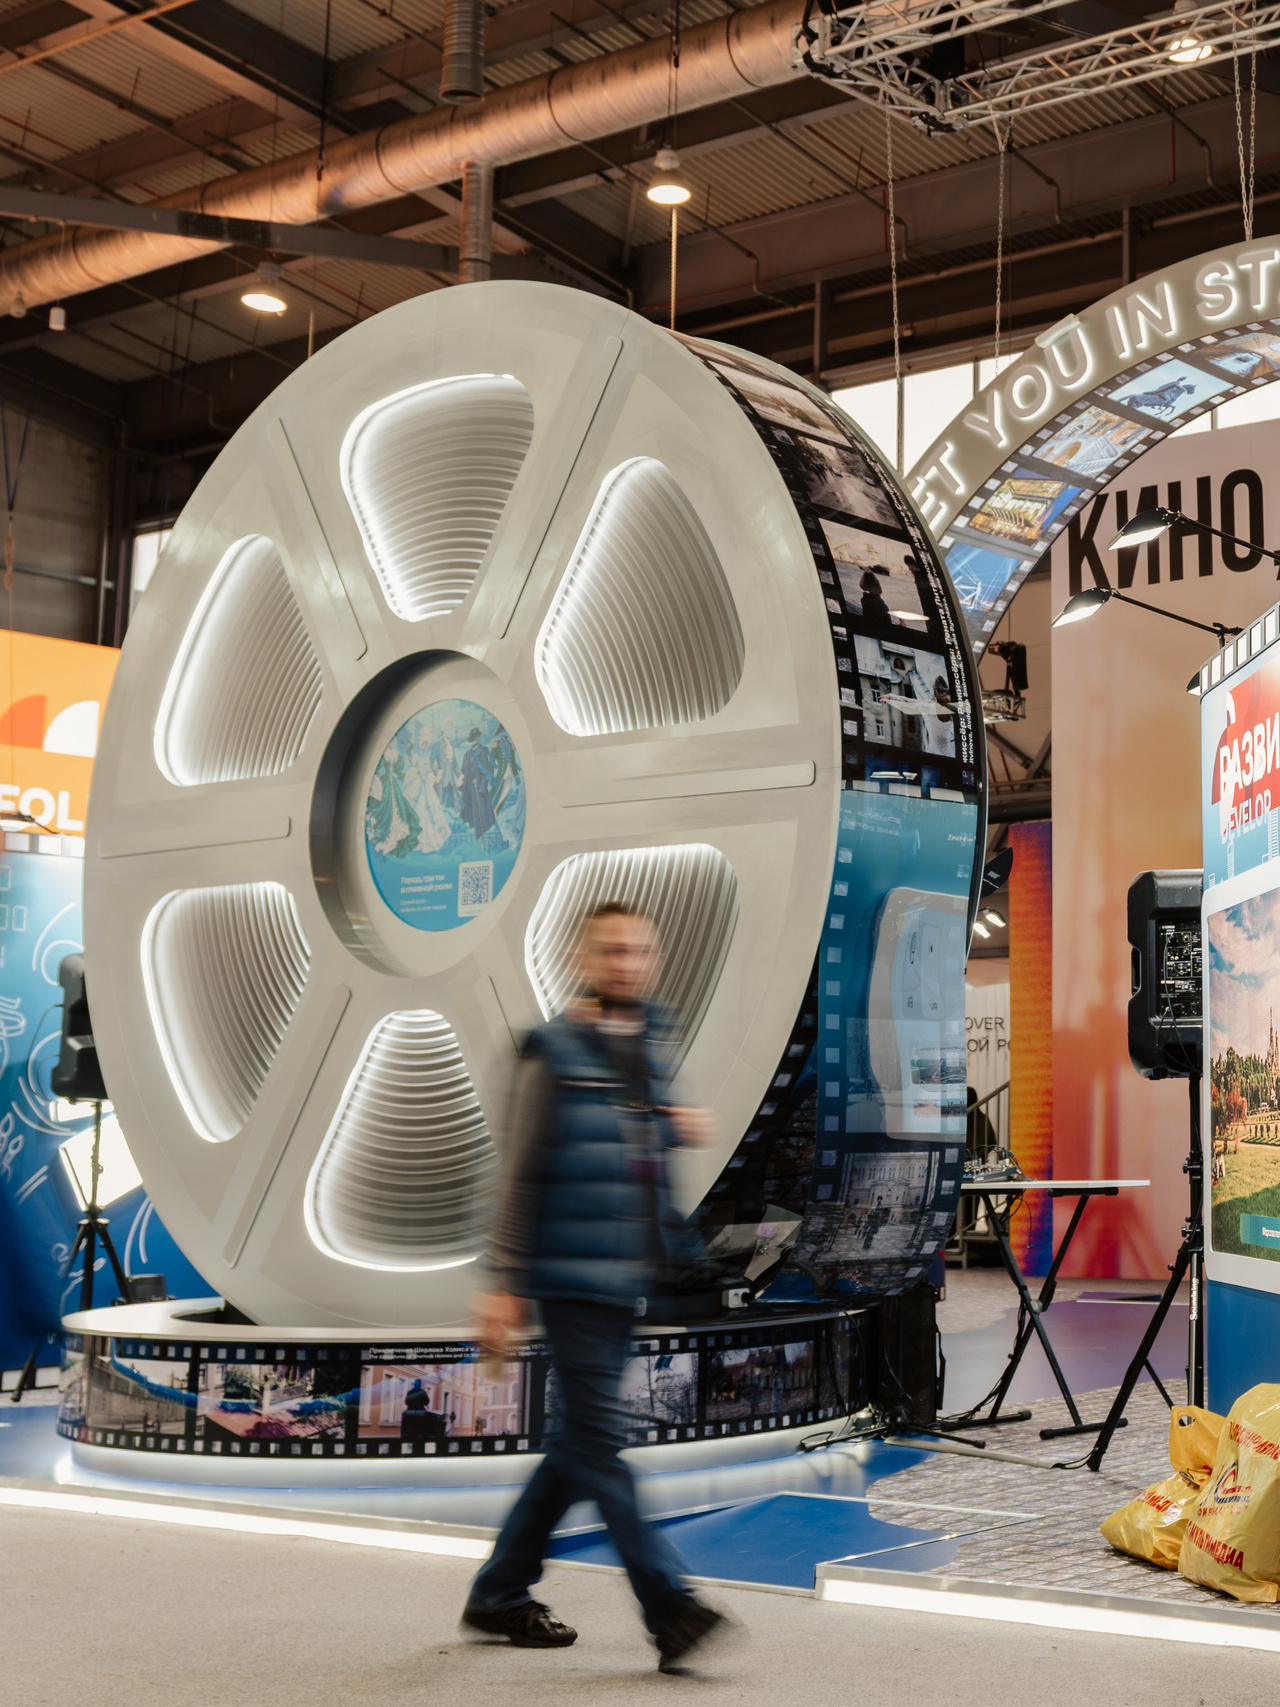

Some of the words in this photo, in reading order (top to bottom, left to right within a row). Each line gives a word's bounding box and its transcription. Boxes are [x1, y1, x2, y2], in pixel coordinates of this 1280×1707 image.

[962, 326, 1096, 449] YOU
[1103, 280, 1178, 360] IN
[1189, 1277, 1199, 1321] Soundking
